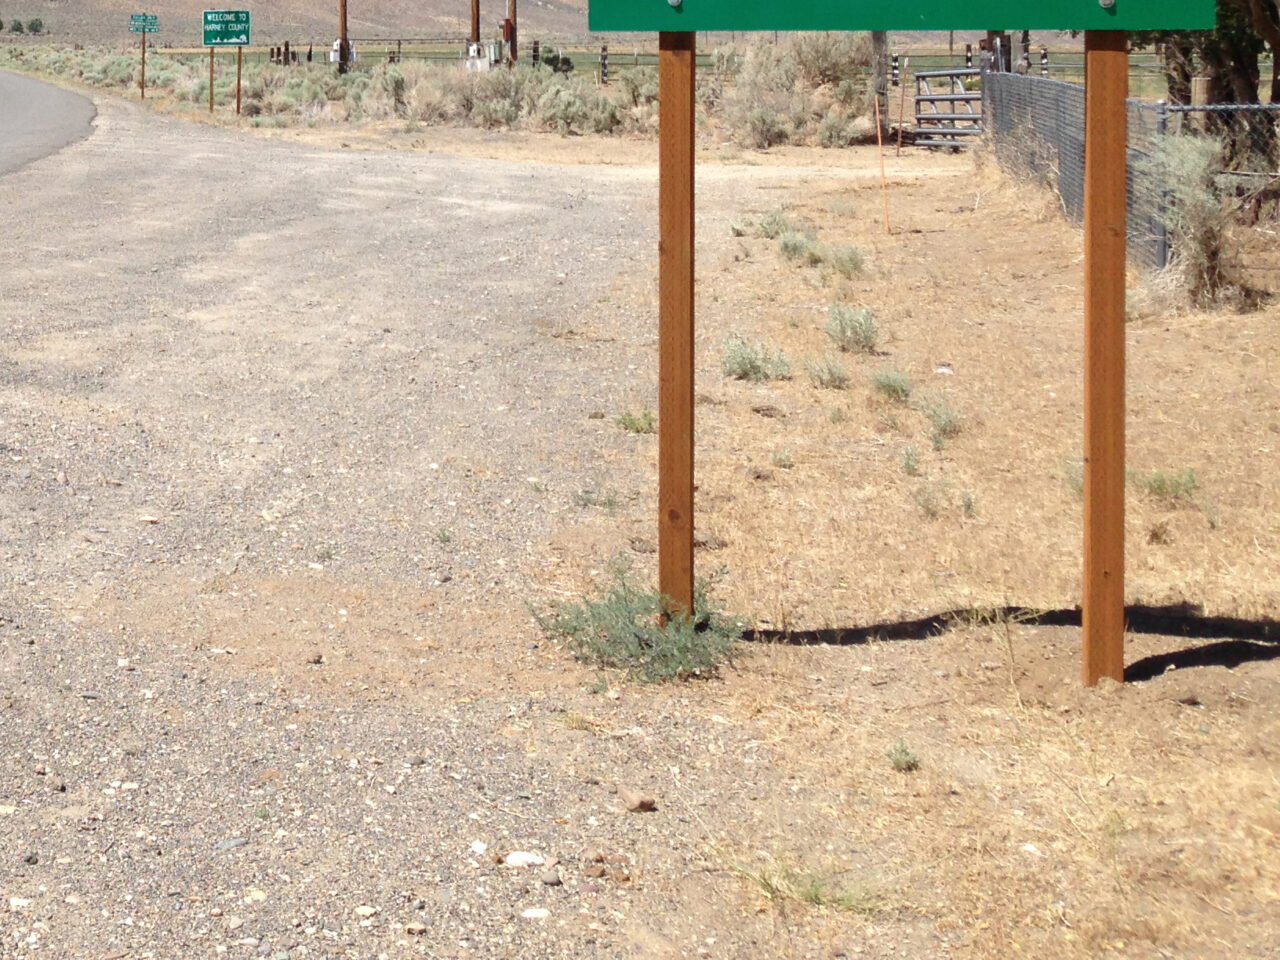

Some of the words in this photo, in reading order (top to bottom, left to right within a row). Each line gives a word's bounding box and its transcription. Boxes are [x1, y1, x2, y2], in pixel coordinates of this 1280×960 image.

[207, 13, 236, 21] WELCOME
[239, 13, 247, 21] TO
[204, 23, 225, 31] HARNEY
[228, 23, 249, 31] COUNTY
